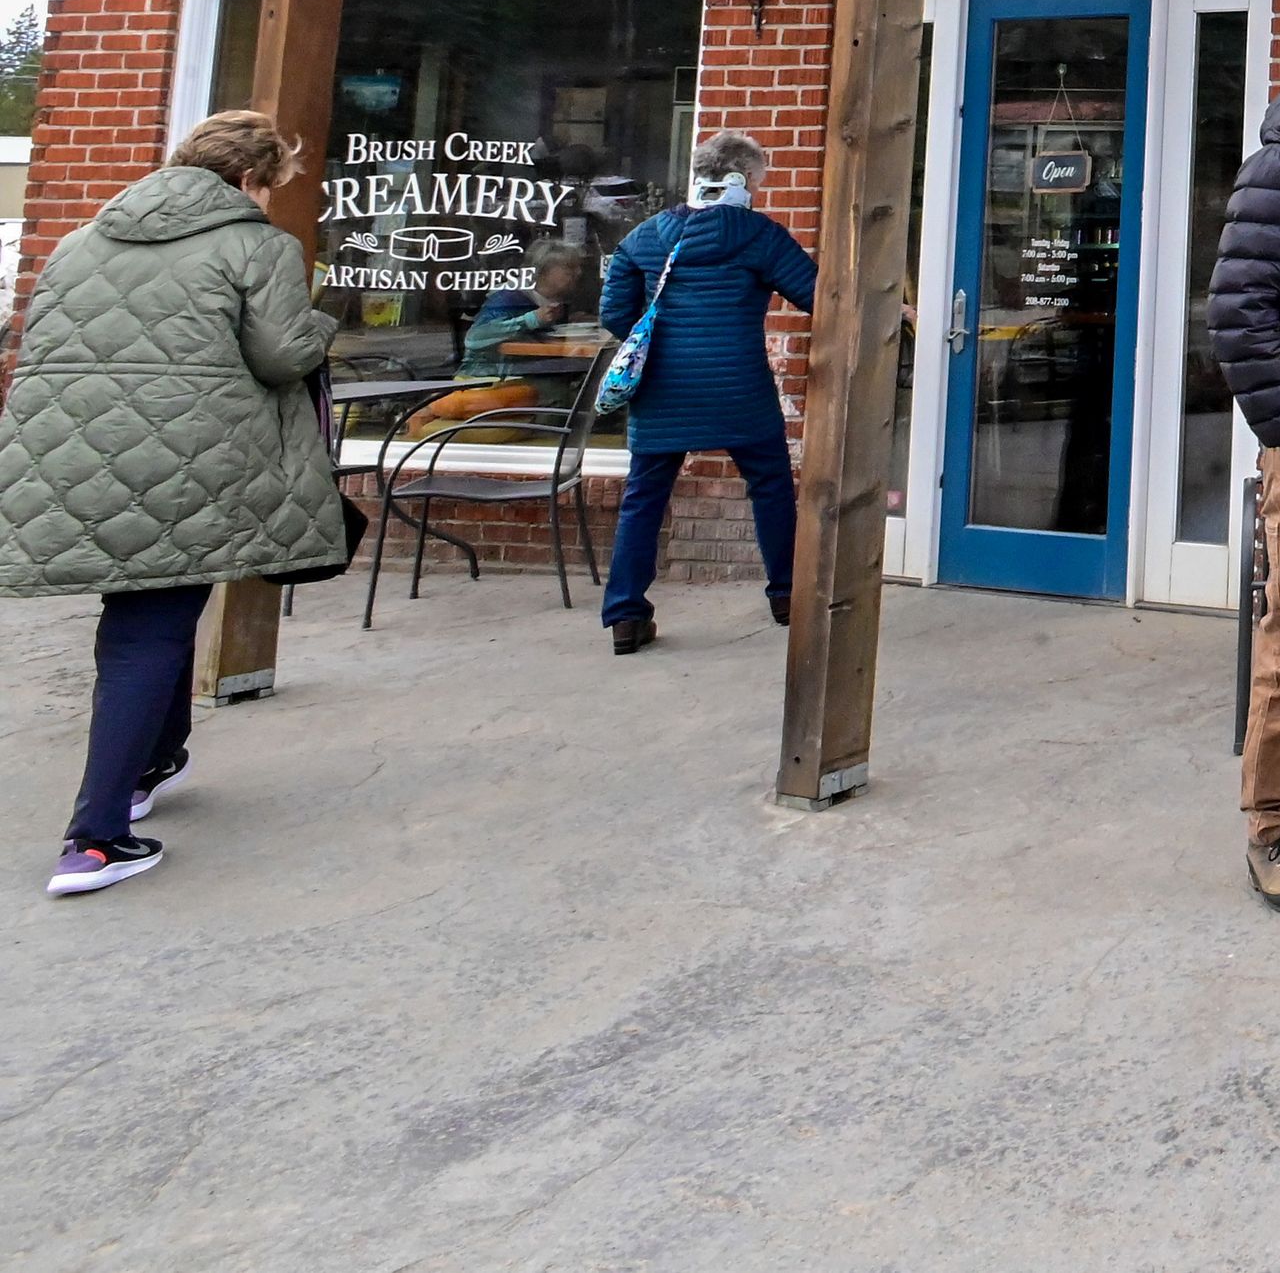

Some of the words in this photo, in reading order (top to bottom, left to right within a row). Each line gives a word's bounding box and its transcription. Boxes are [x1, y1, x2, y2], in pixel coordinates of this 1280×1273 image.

[1042, 161, 1075, 183] Open
[321, 264, 428, 290] ARTISAN
[436, 267, 537, 291] CHEESE
